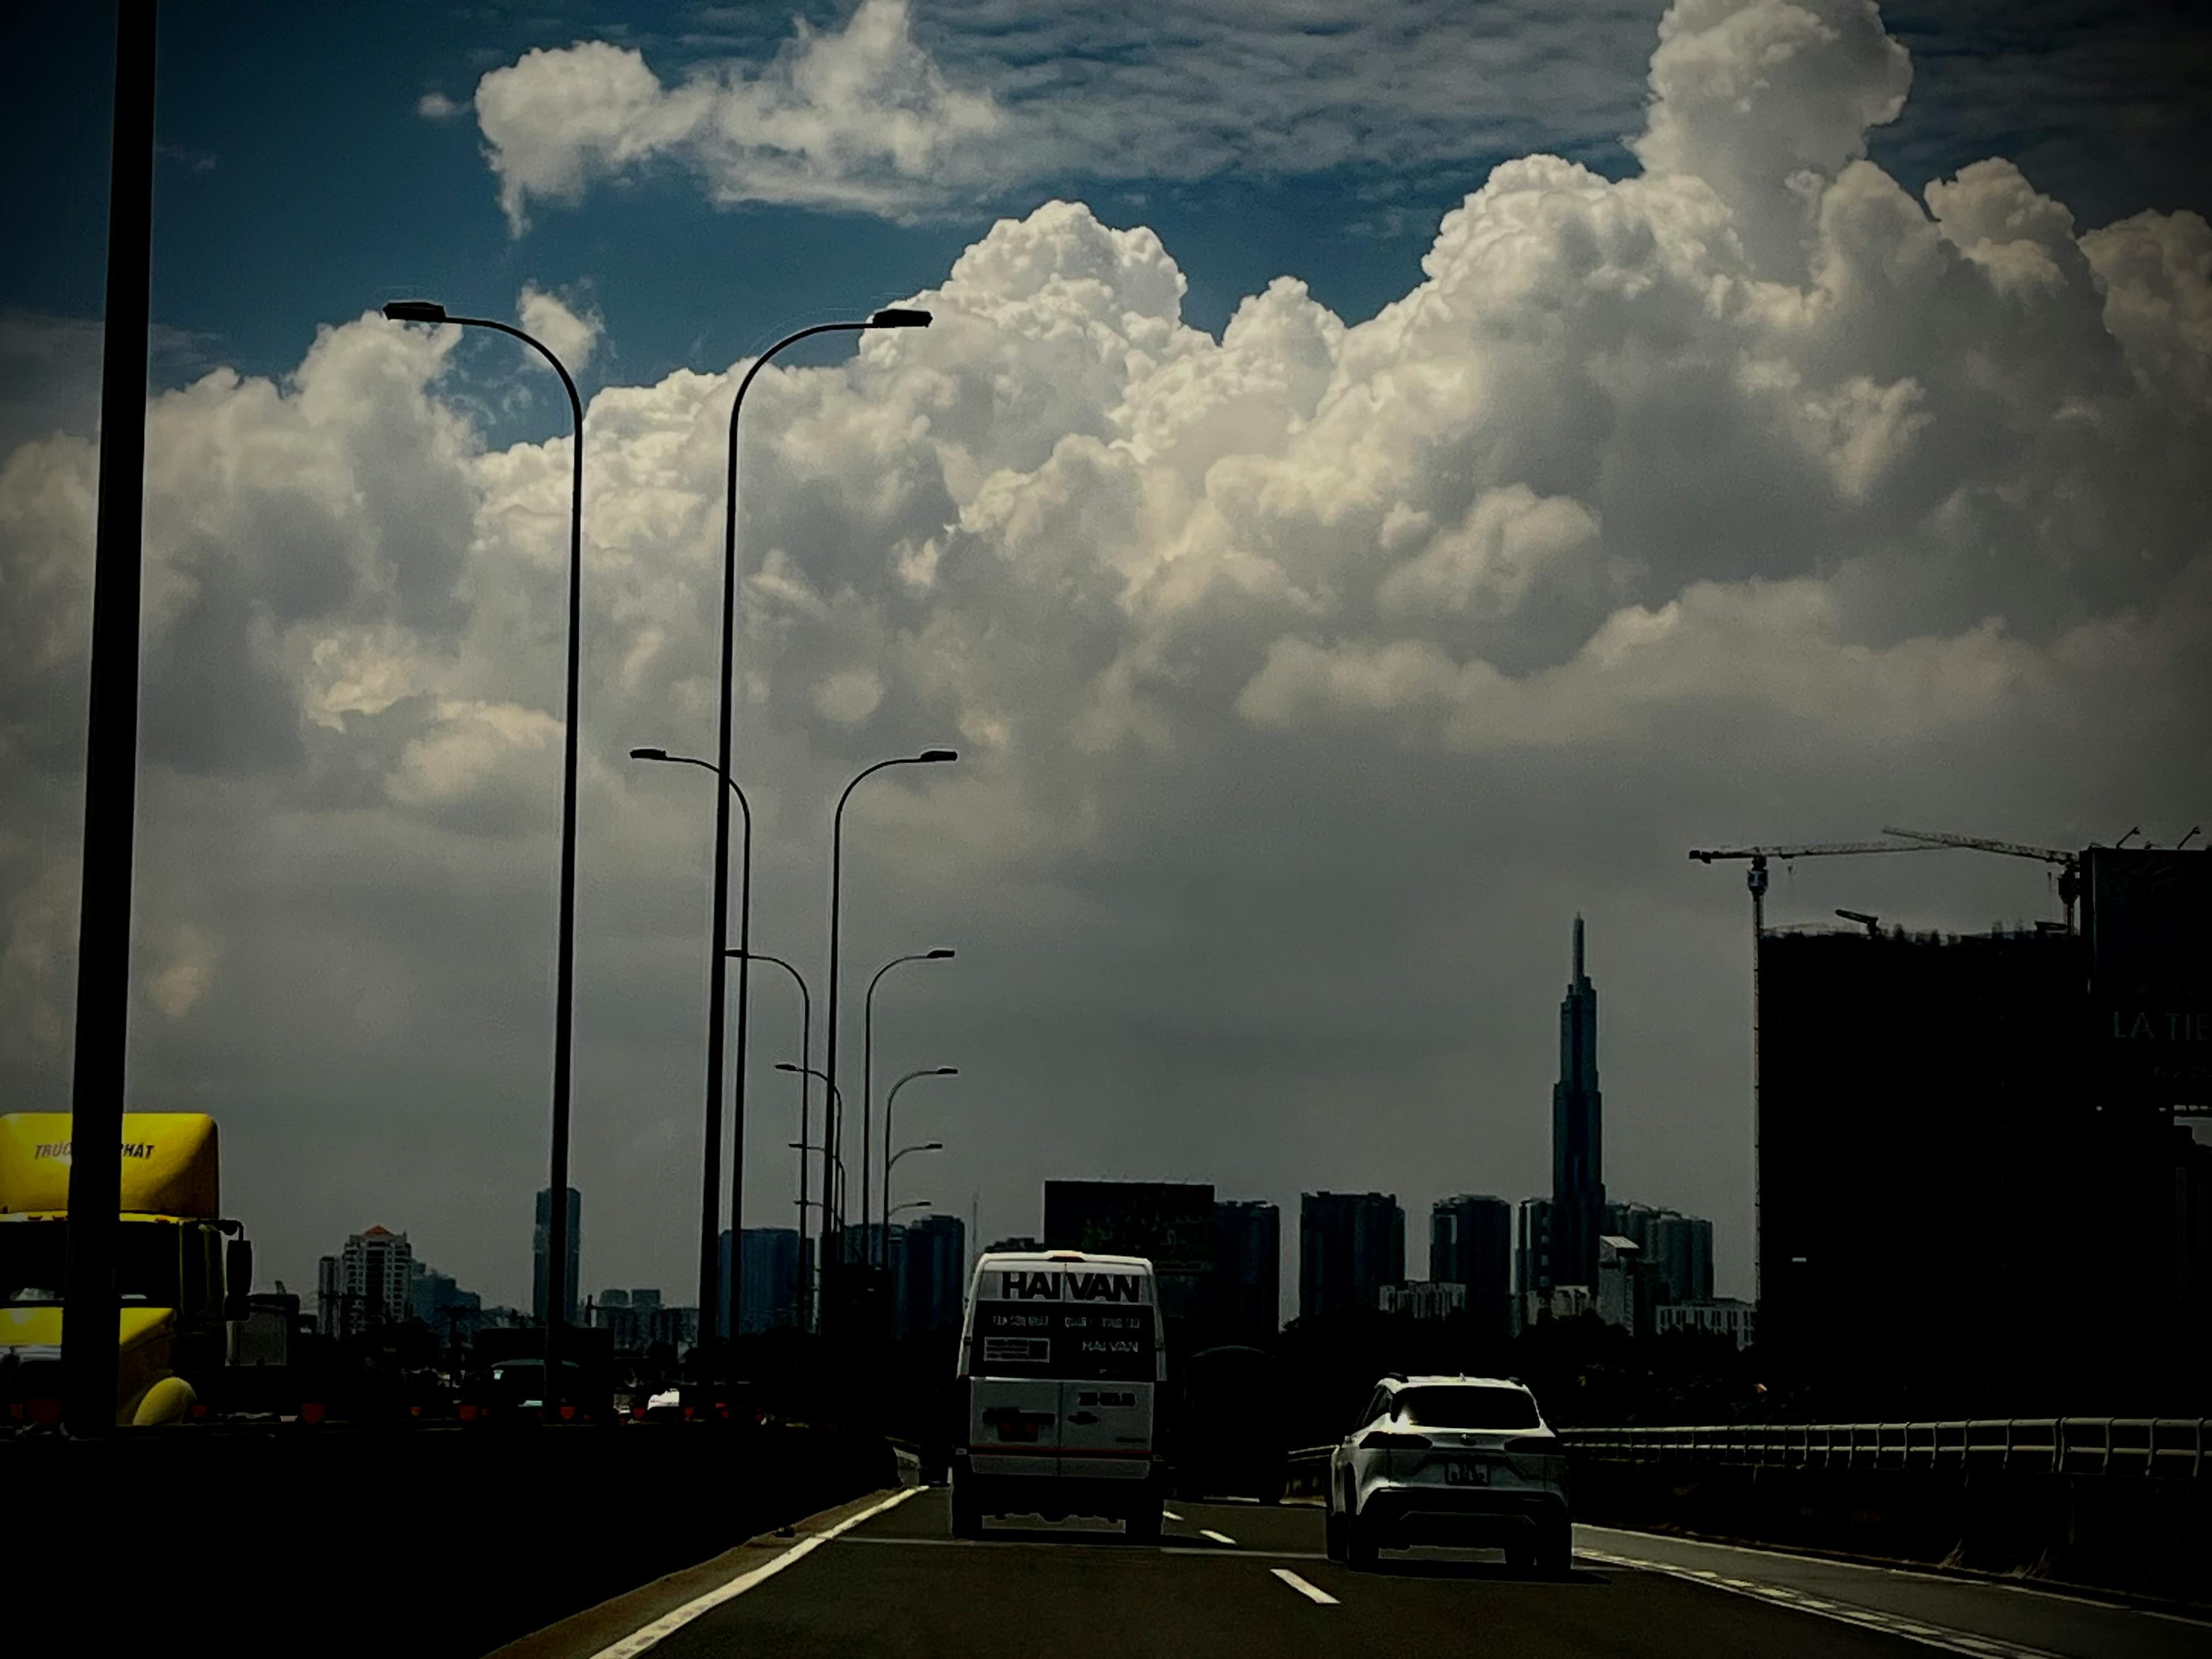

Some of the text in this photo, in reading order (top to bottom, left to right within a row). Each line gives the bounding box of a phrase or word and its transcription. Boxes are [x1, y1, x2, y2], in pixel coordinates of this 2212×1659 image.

[2113, 1012, 2156, 1041] LA
[1002, 1271, 1139, 1303] HAI VAN
